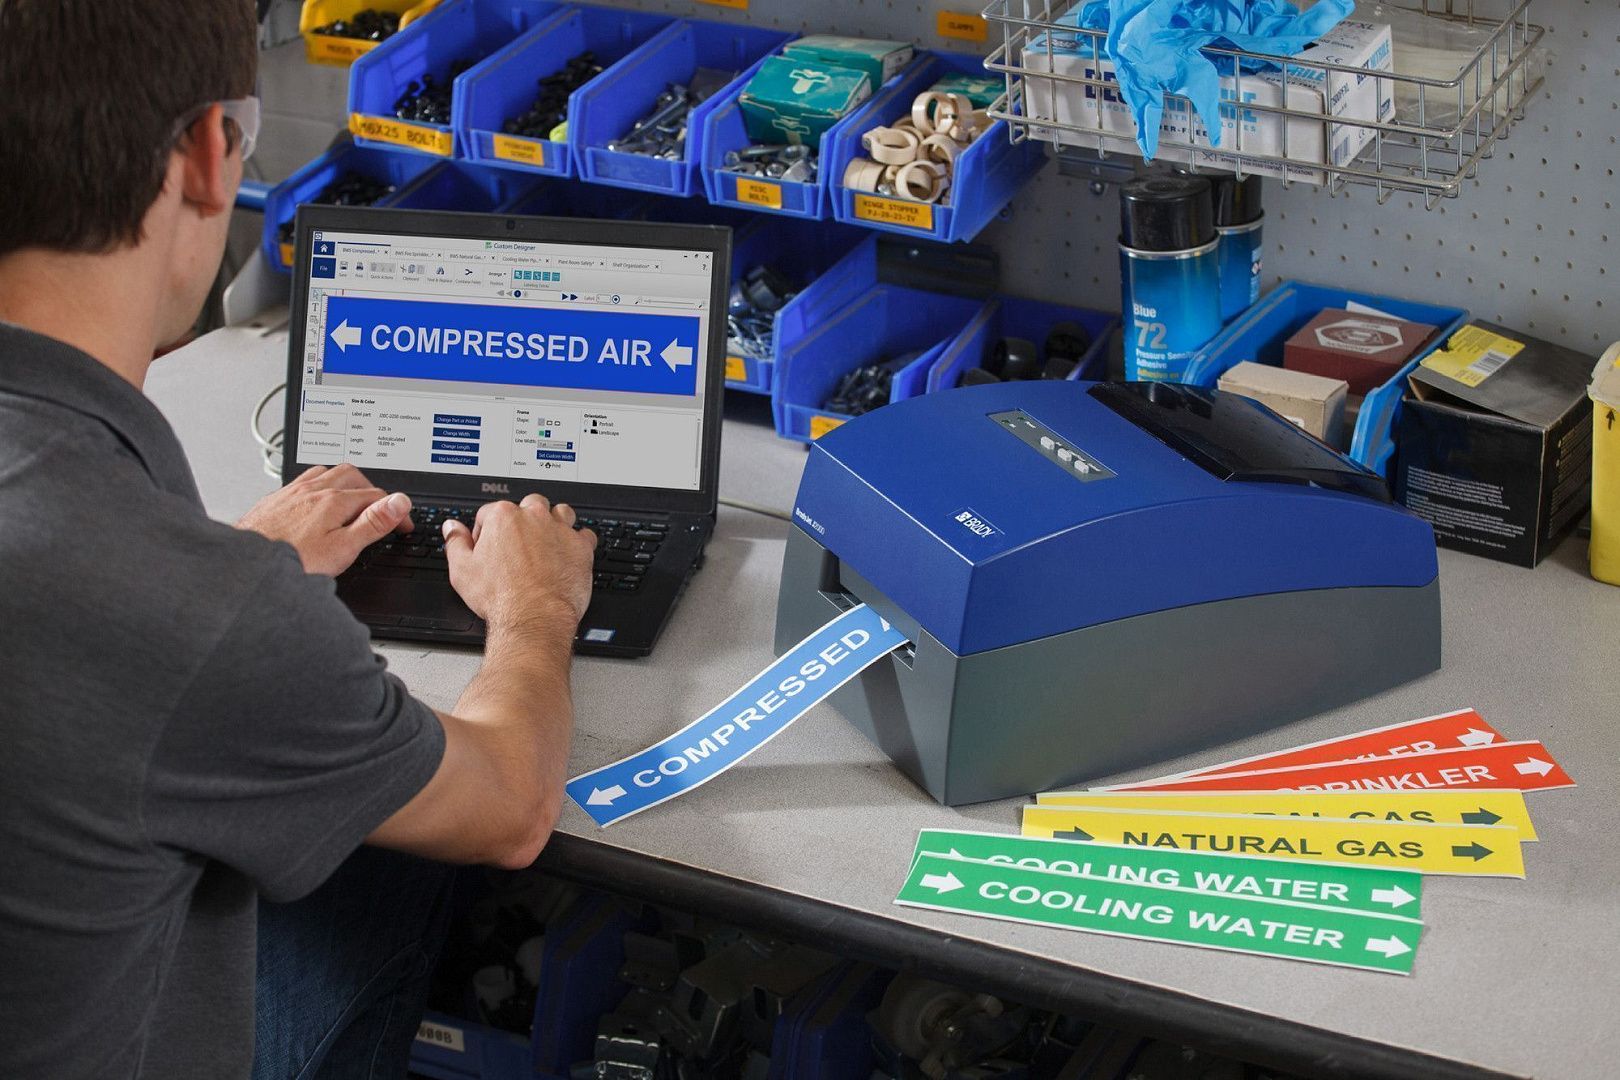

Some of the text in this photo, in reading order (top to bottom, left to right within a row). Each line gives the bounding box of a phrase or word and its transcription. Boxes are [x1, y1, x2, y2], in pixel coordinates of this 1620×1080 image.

[493, 242, 536, 252] Custom Designer
[1133, 303, 1157, 319] Blue
[371, 324, 653, 367] COMPRESSED AIR
[1134, 320, 1168, 350] 72
[1136, 348, 1166, 360] Pressure
[1136, 358, 1168, 369] Adhesive
[481, 482, 510, 494] DELL
[963, 517, 996, 538] BRADY
[632, 628, 871, 789] COMPRESSED
[1122, 831, 1424, 859] NATURAL GAS
[1193, 871, 1350, 901] WATER
[978, 881, 1345, 949] COOLING WATER
